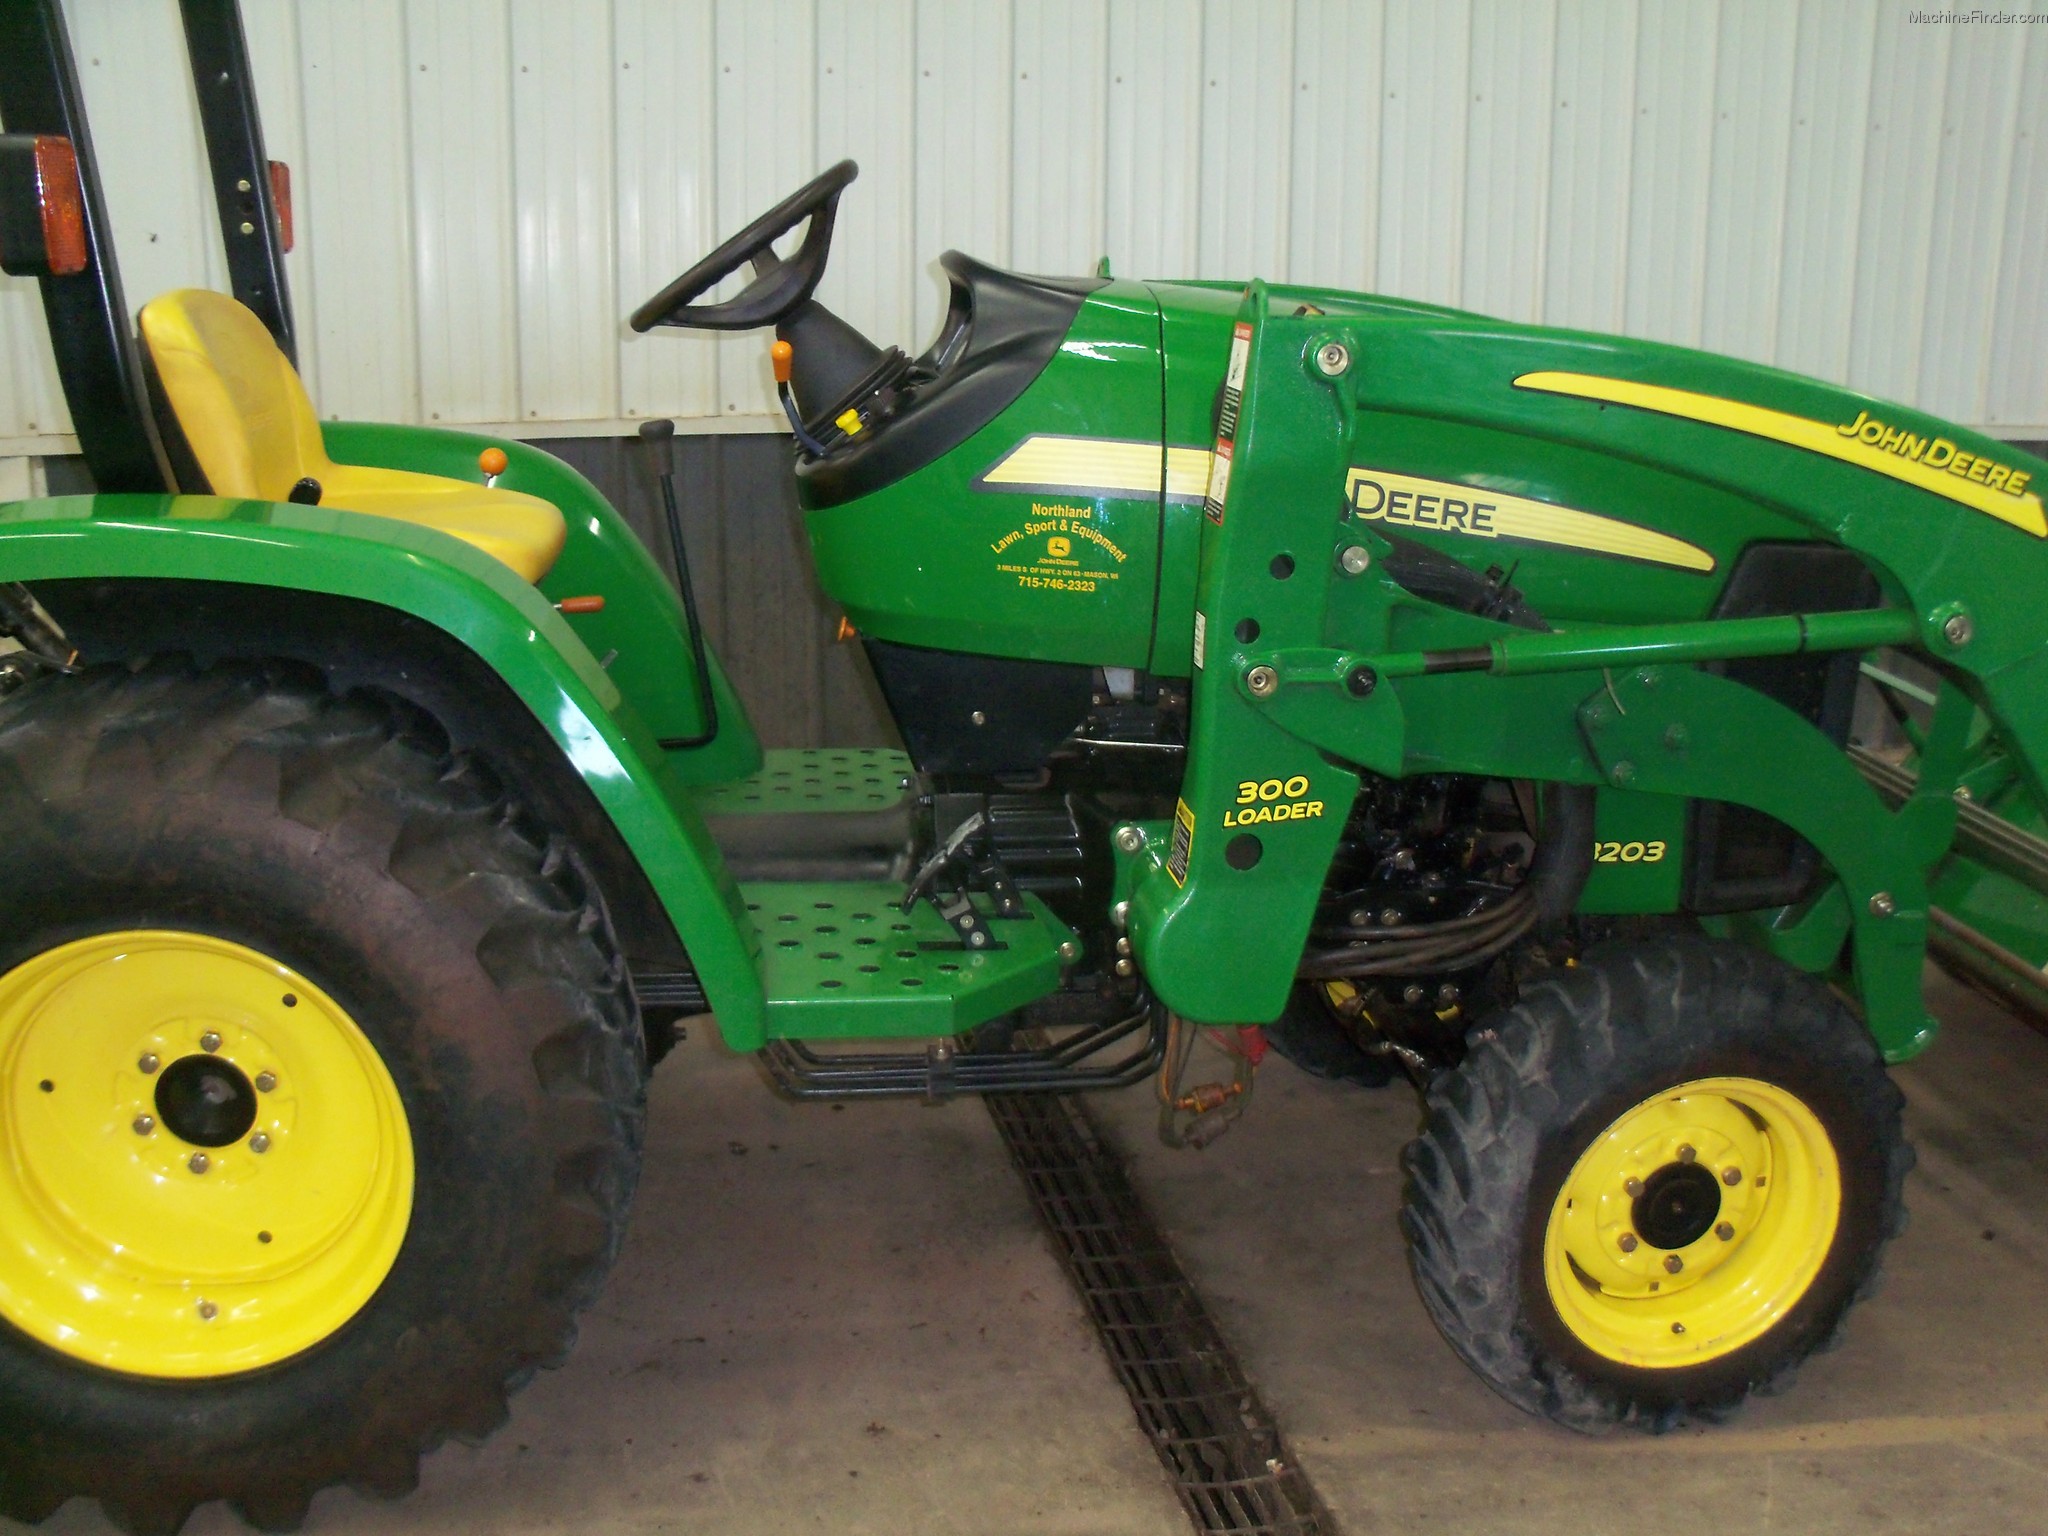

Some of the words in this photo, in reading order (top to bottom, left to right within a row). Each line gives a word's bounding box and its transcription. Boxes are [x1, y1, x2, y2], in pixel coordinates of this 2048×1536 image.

[1837, 411, 1928, 461] JOHN
[1922, 437, 2031, 496] DEERE
[1031, 503, 1092, 518] Northland
[1352, 478, 1497, 532] DEERE
[990, 530, 1025, 554] Lawn,
[1024, 519, 1057, 536] Sport
[1059, 519, 1068, 532] &
[1071, 520, 1128, 563] Equipment
[1018, 575, 1096, 592] 715-746-2323
[1236, 775, 1310, 804] 300
[1223, 800, 1324, 828] LOADER
